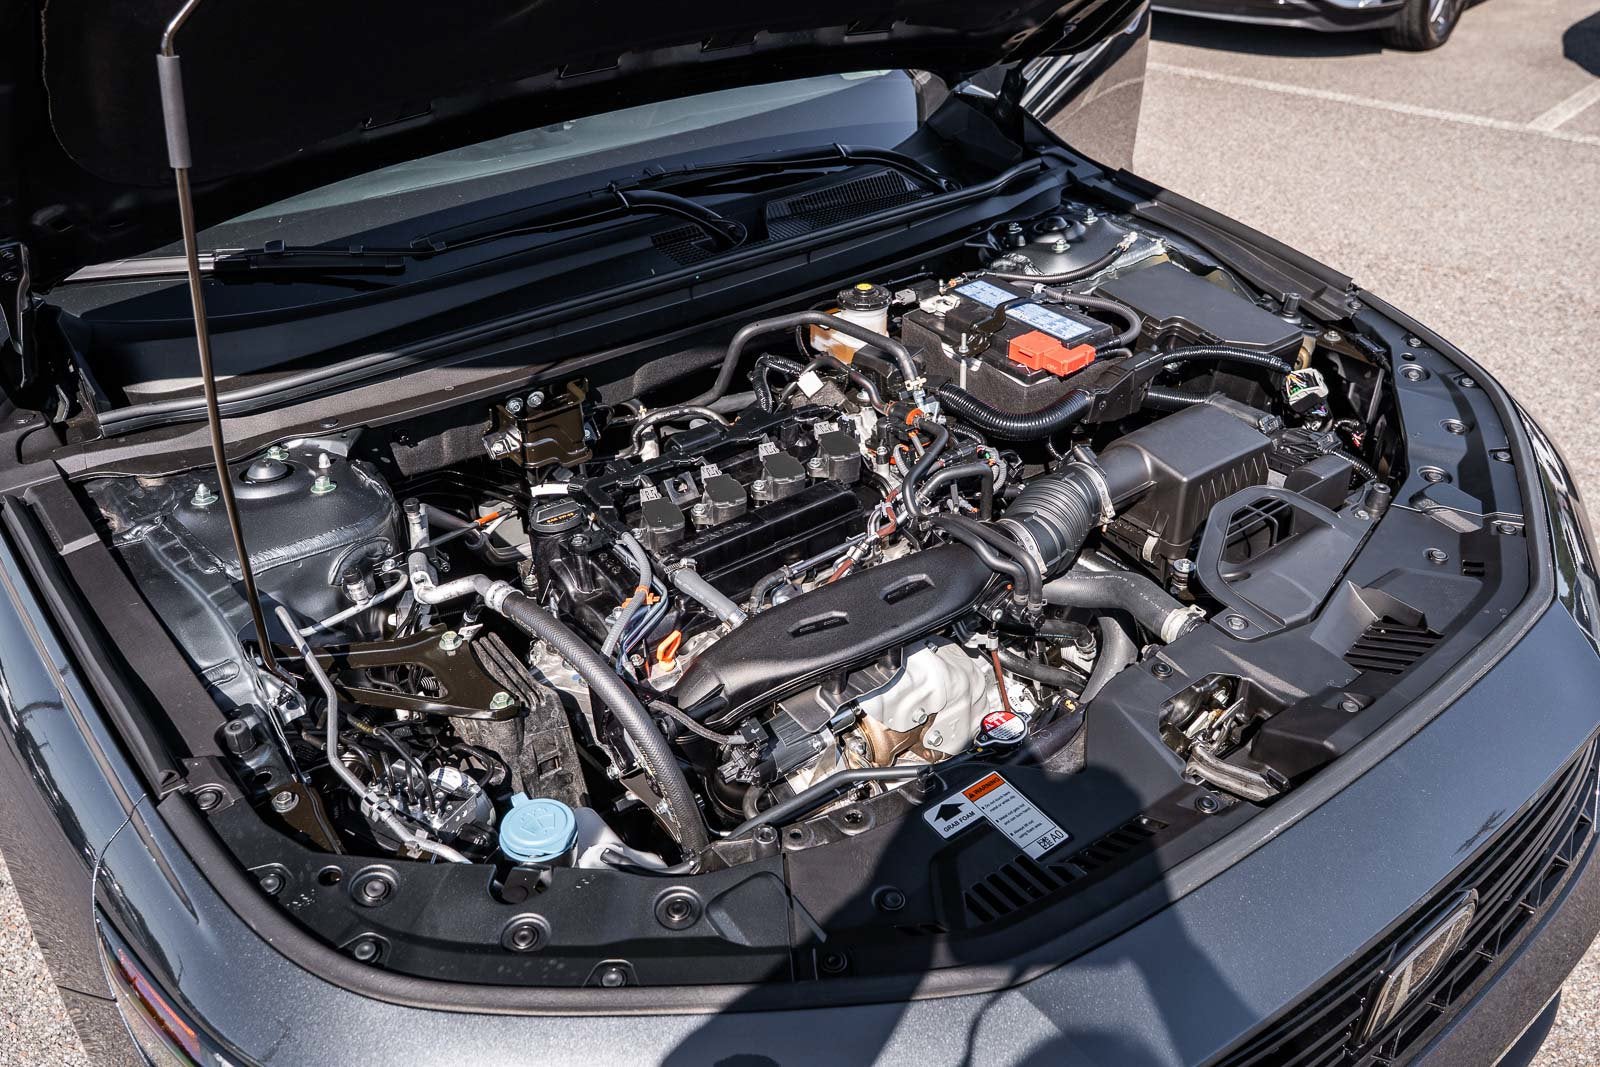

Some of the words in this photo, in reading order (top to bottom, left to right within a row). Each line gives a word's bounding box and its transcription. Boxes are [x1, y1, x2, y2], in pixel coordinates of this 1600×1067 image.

[677, 522, 752, 552] HONDA
[974, 776, 1000, 795] WARNING
[943, 819, 960, 833] GRAB
[959, 810, 976, 824] FOAM
[1052, 830, 1064, 844] A0
